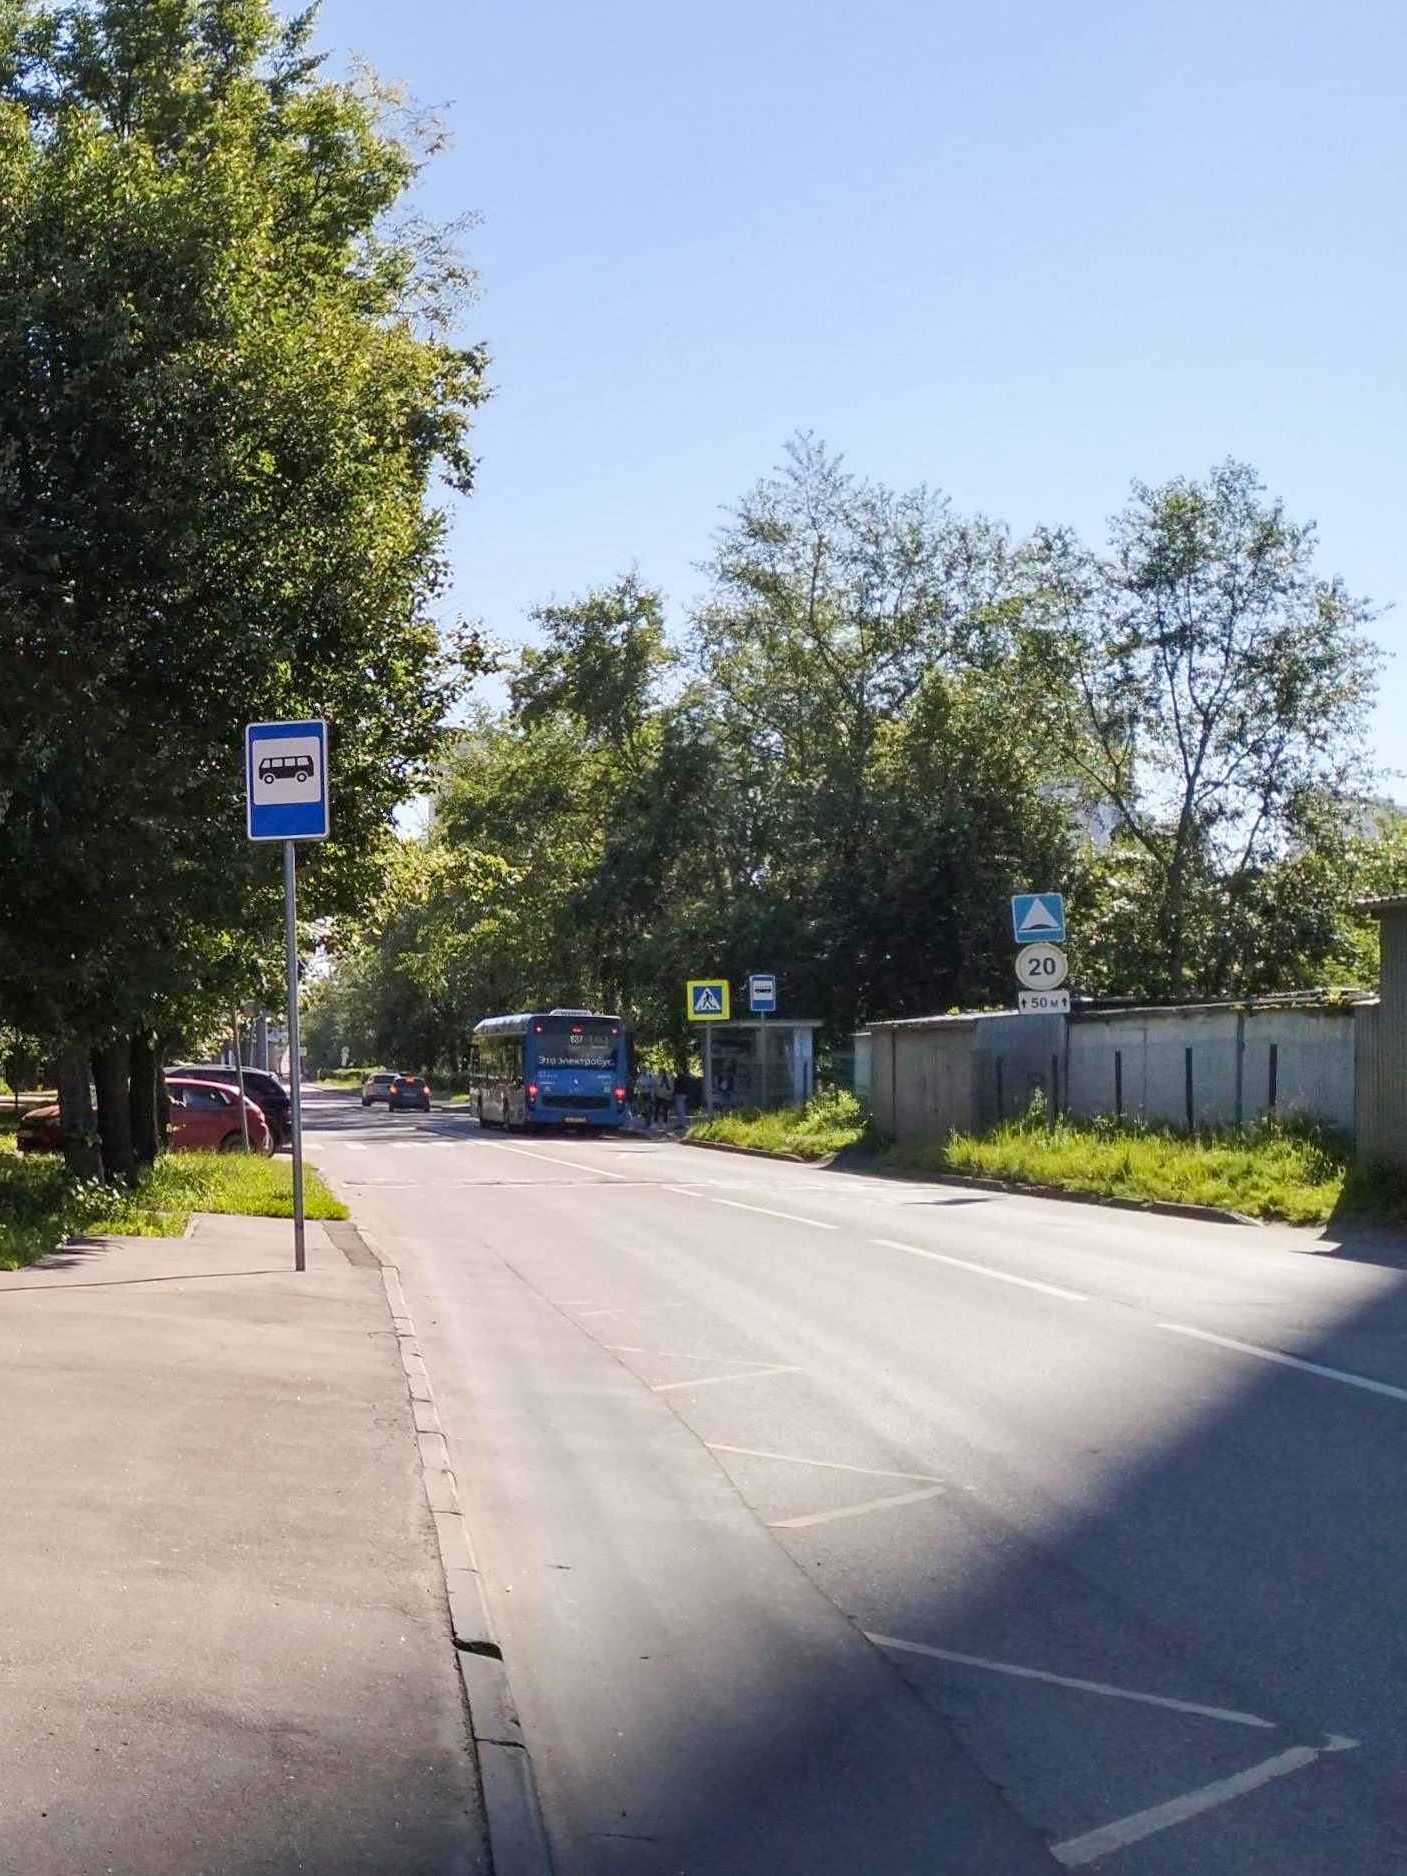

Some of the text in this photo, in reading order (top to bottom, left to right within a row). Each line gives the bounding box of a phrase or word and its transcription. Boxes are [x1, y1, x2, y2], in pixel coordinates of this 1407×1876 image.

[1028, 957, 1056, 976] 20
[1031, 998, 1048, 1009] 50
[537, 1056, 557, 1066] Это
